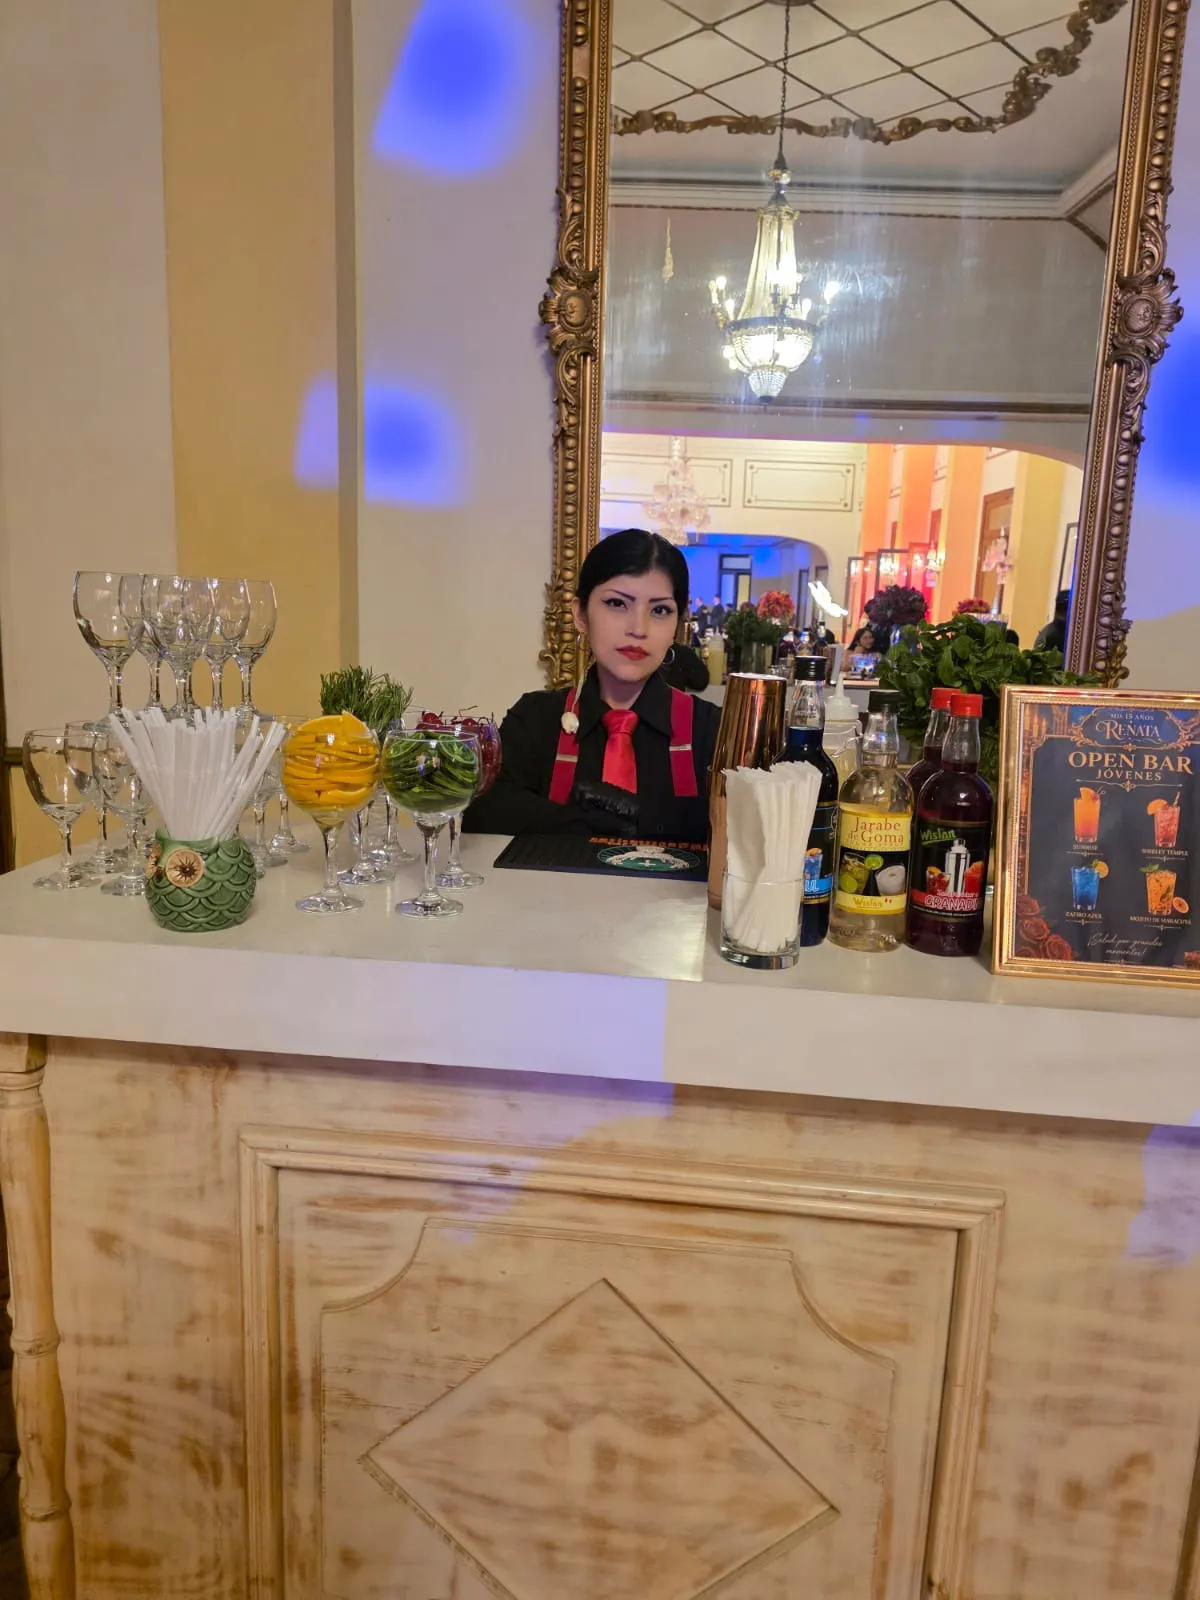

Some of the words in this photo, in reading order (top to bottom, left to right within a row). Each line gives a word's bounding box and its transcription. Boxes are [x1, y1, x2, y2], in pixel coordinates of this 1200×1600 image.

[1096, 719, 1160, 740] RENATA
[1068, 751, 1136, 768] OPEN
[1143, 754, 1194, 775] BAR
[1096, 768, 1162, 781] JÓVENES
[854, 817, 901, 832] Jarabe
[861, 830, 904, 843] Goma
